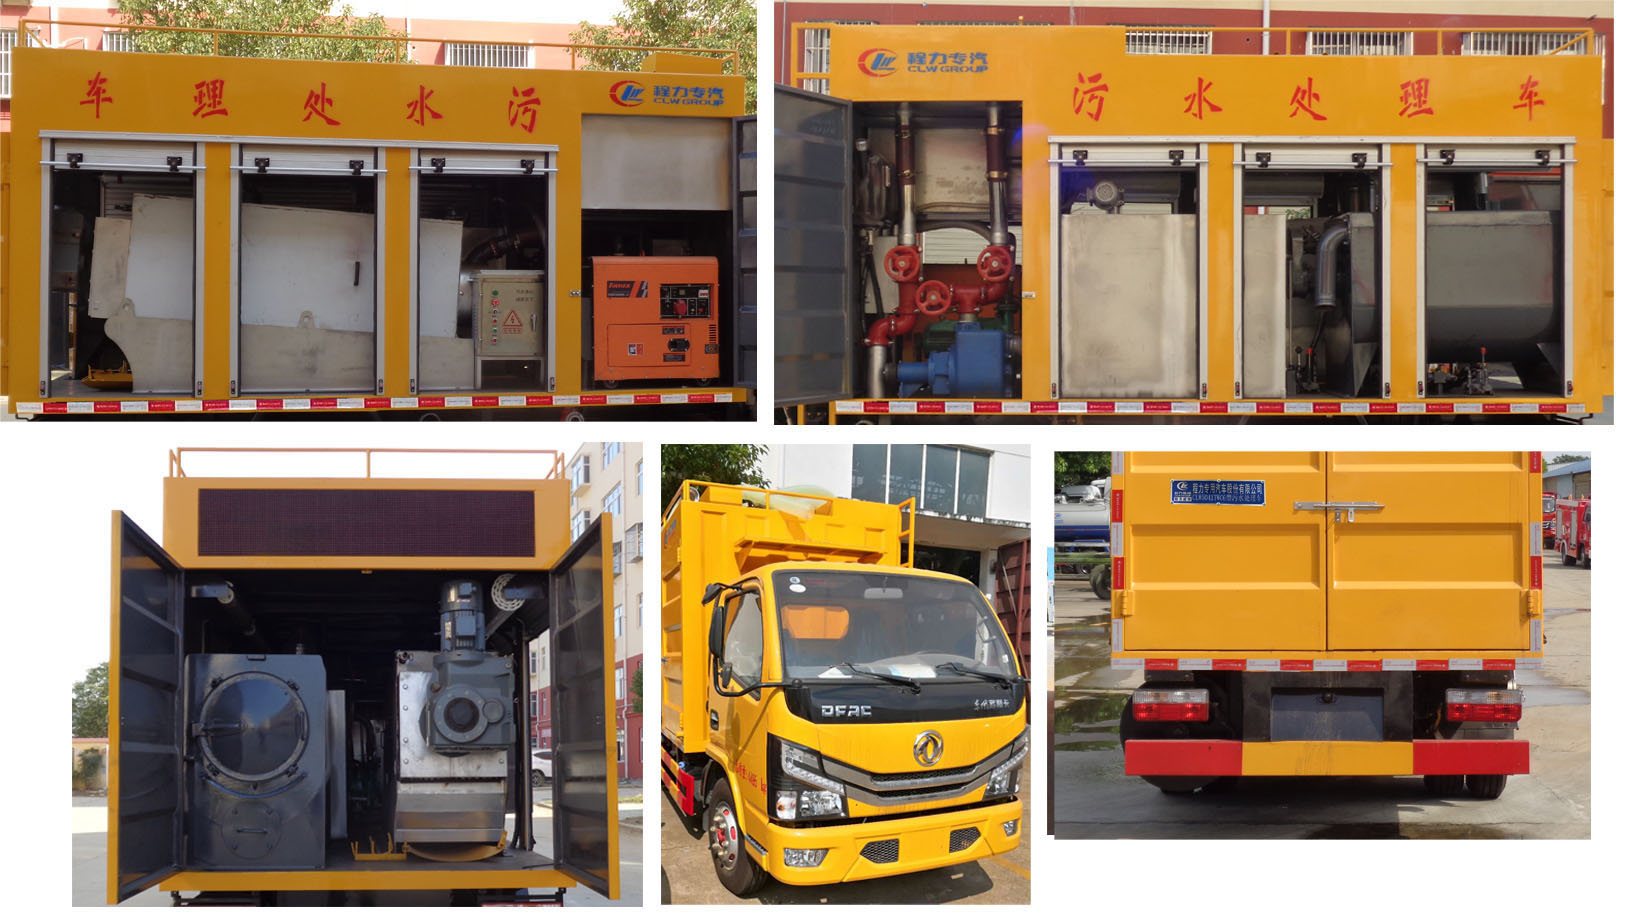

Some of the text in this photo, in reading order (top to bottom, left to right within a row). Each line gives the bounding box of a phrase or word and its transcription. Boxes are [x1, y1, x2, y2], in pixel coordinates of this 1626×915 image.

[907, 51, 988, 65] 程力专汽
[907, 65, 989, 73] CLW GROUP
[653, 85, 724, 99] 程力专汽
[653, 97, 724, 106] CLW GROUP
[821, 704, 872, 718] DFAC
